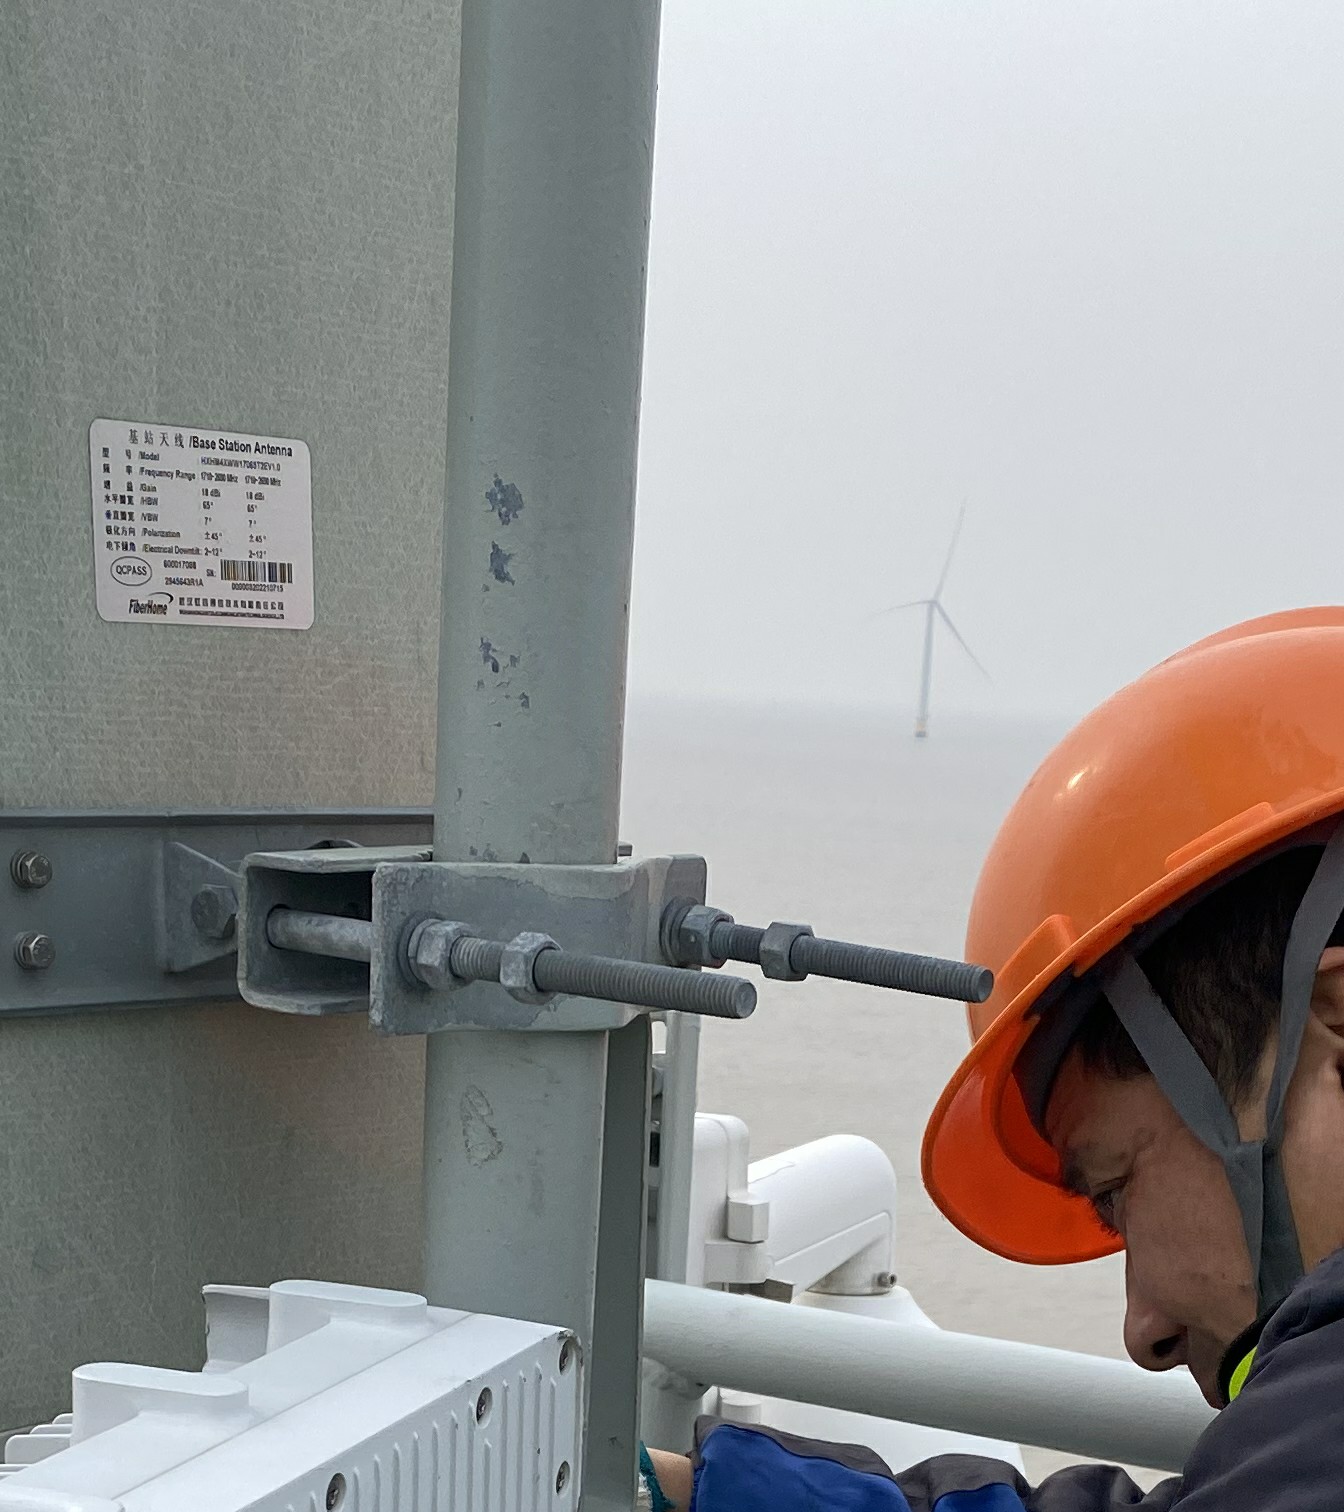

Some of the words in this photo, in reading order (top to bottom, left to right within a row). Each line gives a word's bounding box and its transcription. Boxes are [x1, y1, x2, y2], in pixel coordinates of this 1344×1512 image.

[218, 438, 251, 454] Station
[254, 442, 293, 457] Antenna
[175, 470, 196, 481] Range
[116, 564, 148, 576] QCPASS
[129, 598, 168, 616] FiberHome
